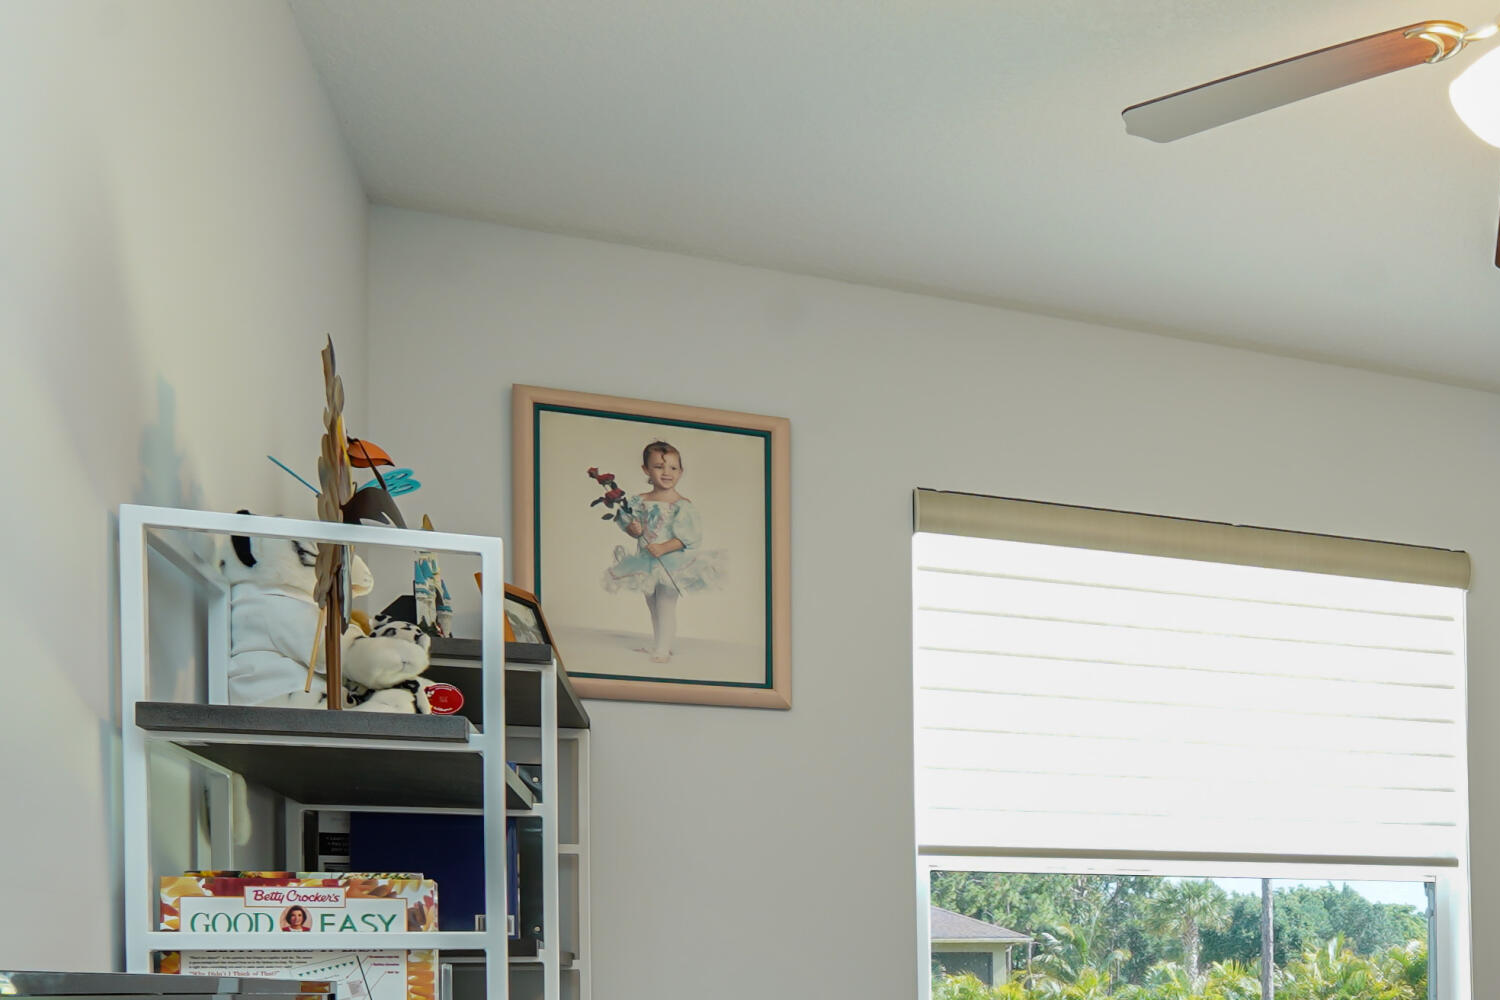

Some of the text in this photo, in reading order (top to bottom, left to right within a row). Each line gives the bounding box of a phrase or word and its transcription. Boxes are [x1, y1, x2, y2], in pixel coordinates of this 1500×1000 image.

[253, 889, 340, 904] Betty Crocker's
[190, 912, 397, 932] GOOD EASY
